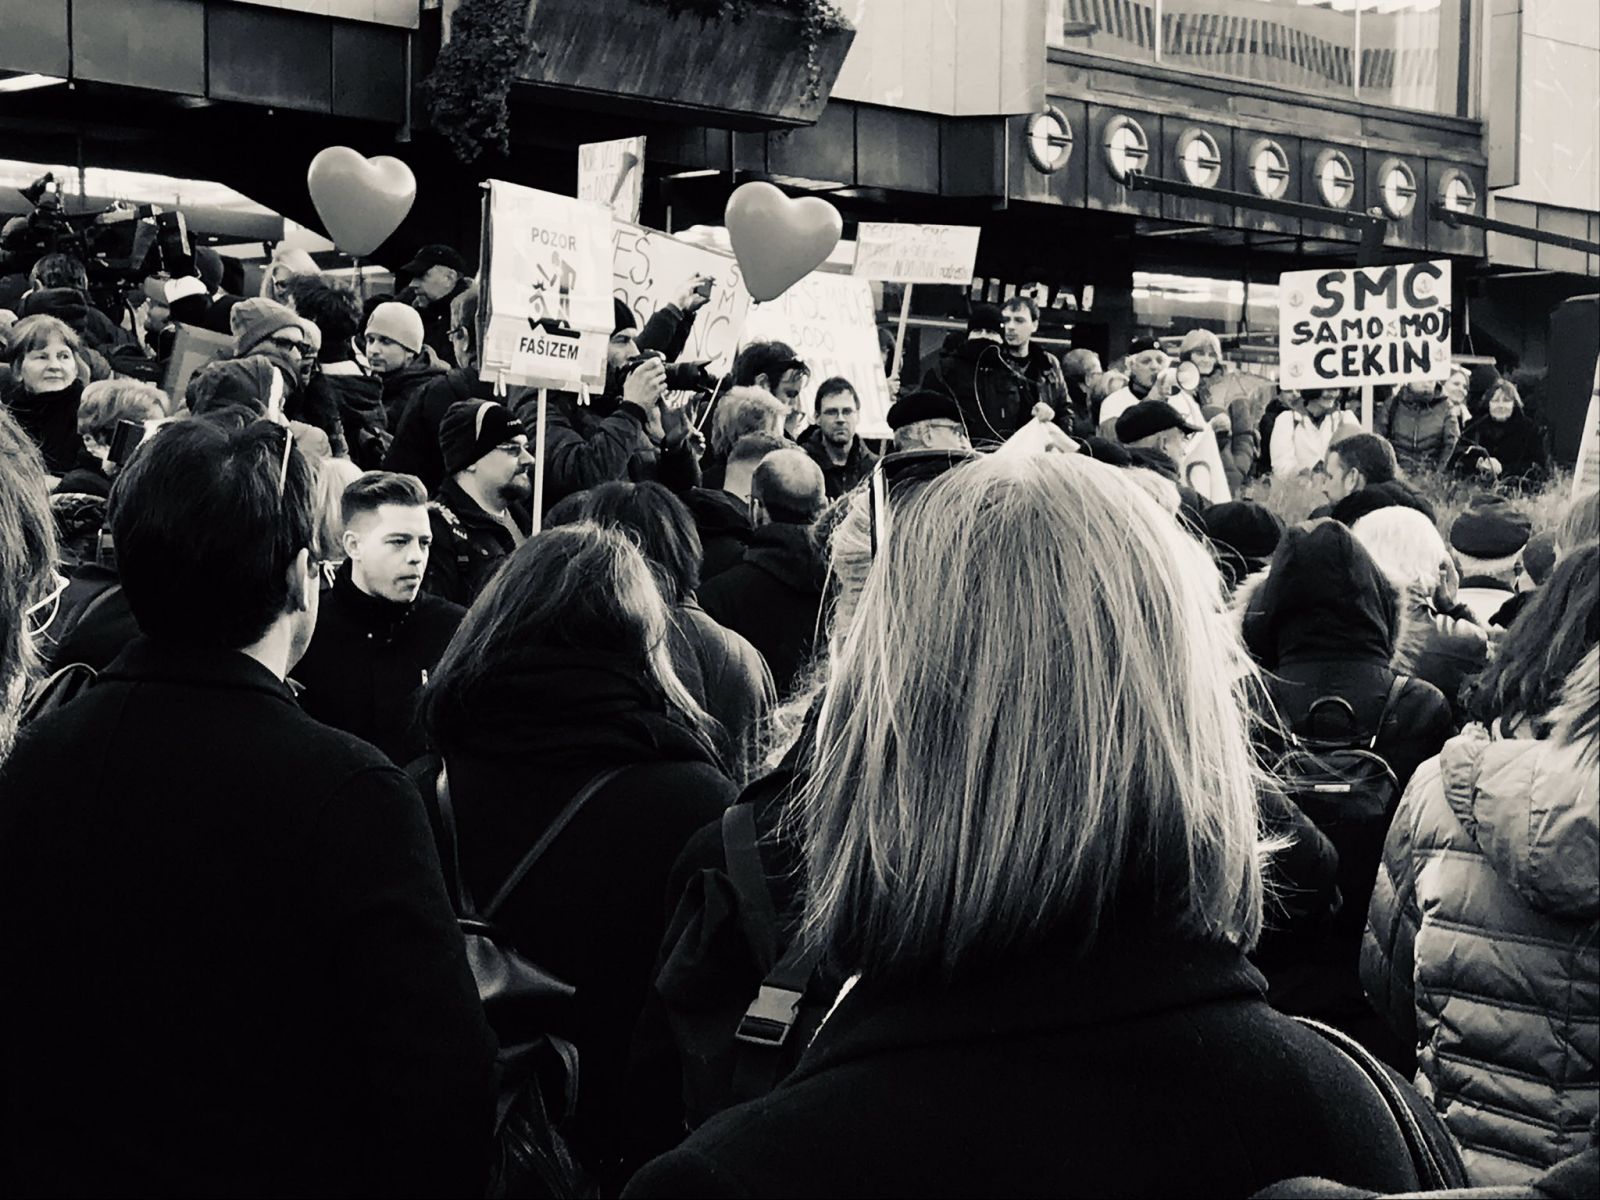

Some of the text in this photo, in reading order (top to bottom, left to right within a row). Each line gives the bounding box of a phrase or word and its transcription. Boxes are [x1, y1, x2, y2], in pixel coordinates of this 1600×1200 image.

[531, 227, 577, 251] POZOR
[1310, 261, 1443, 318] SMC
[1291, 317, 1384, 345] SAMO
[1399, 306, 1451, 343] MOJ
[519, 336, 579, 361] FAŠIZEM
[1313, 340, 1431, 379] CEKIN
